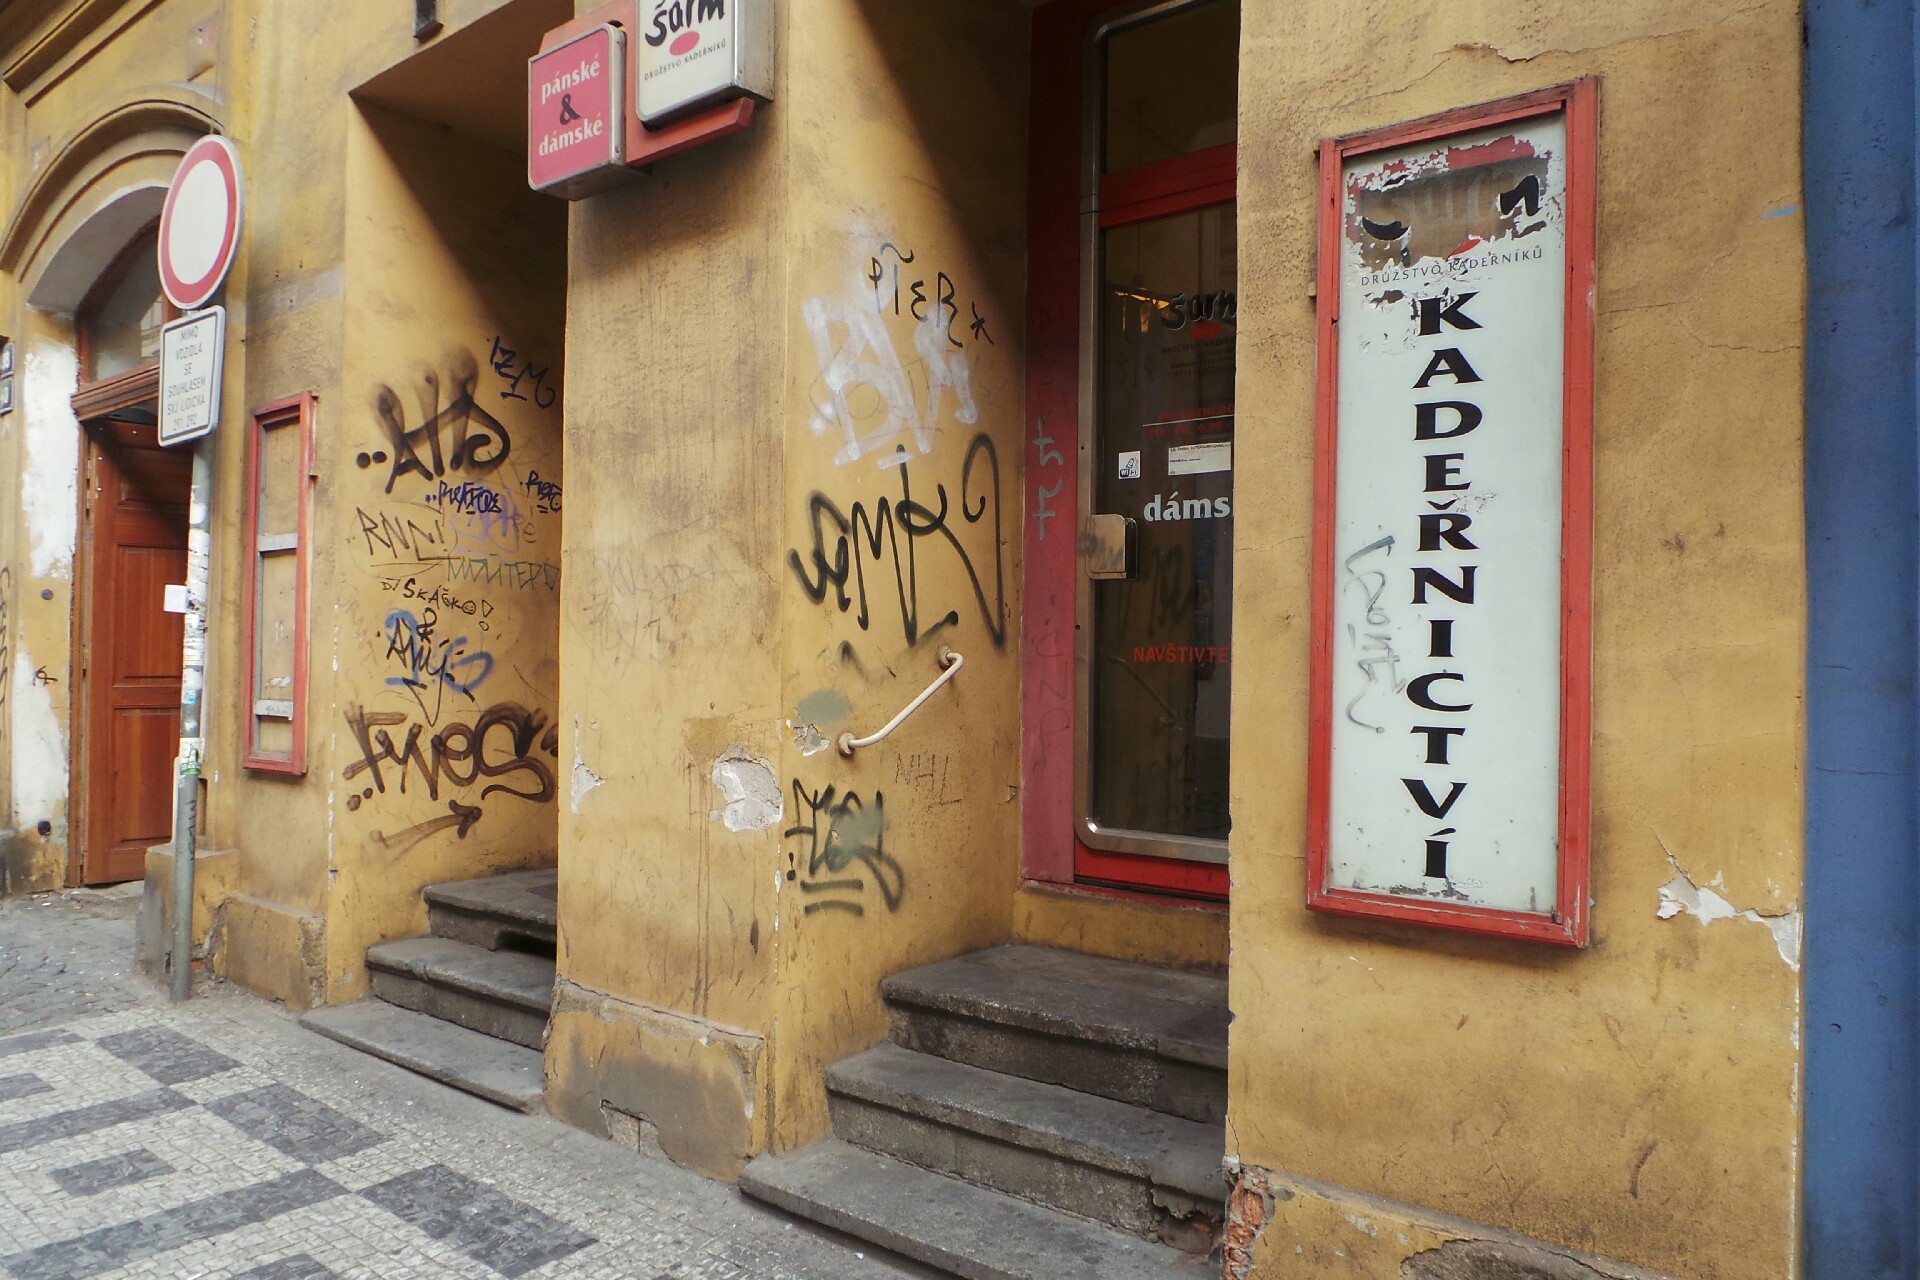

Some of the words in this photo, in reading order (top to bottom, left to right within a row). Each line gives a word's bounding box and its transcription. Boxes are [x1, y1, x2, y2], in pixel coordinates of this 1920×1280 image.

[644, 60, 682, 81] DRUŽSTVO
[684, 38, 727, 64] KADEŘNÍKŮ
[541, 54, 600, 104] pánské
[559, 93, 582, 126] &
[538, 112, 603, 157] dámské
[1361, 264, 1442, 287] DRUŽSTVO
[1449, 245, 1543, 272] KADEŘNÍKŮ
[181, 326, 199, 342] MIMO
[175, 343, 203, 360] VOZIDLA
[184, 362, 193, 375] SE
[168, 376, 206, 398] SOUHLASEM
[1400, 290, 1485, 879] KADEŘNICTVÍ
[1133, 643, 1229, 664] NAVŠTIVTE
